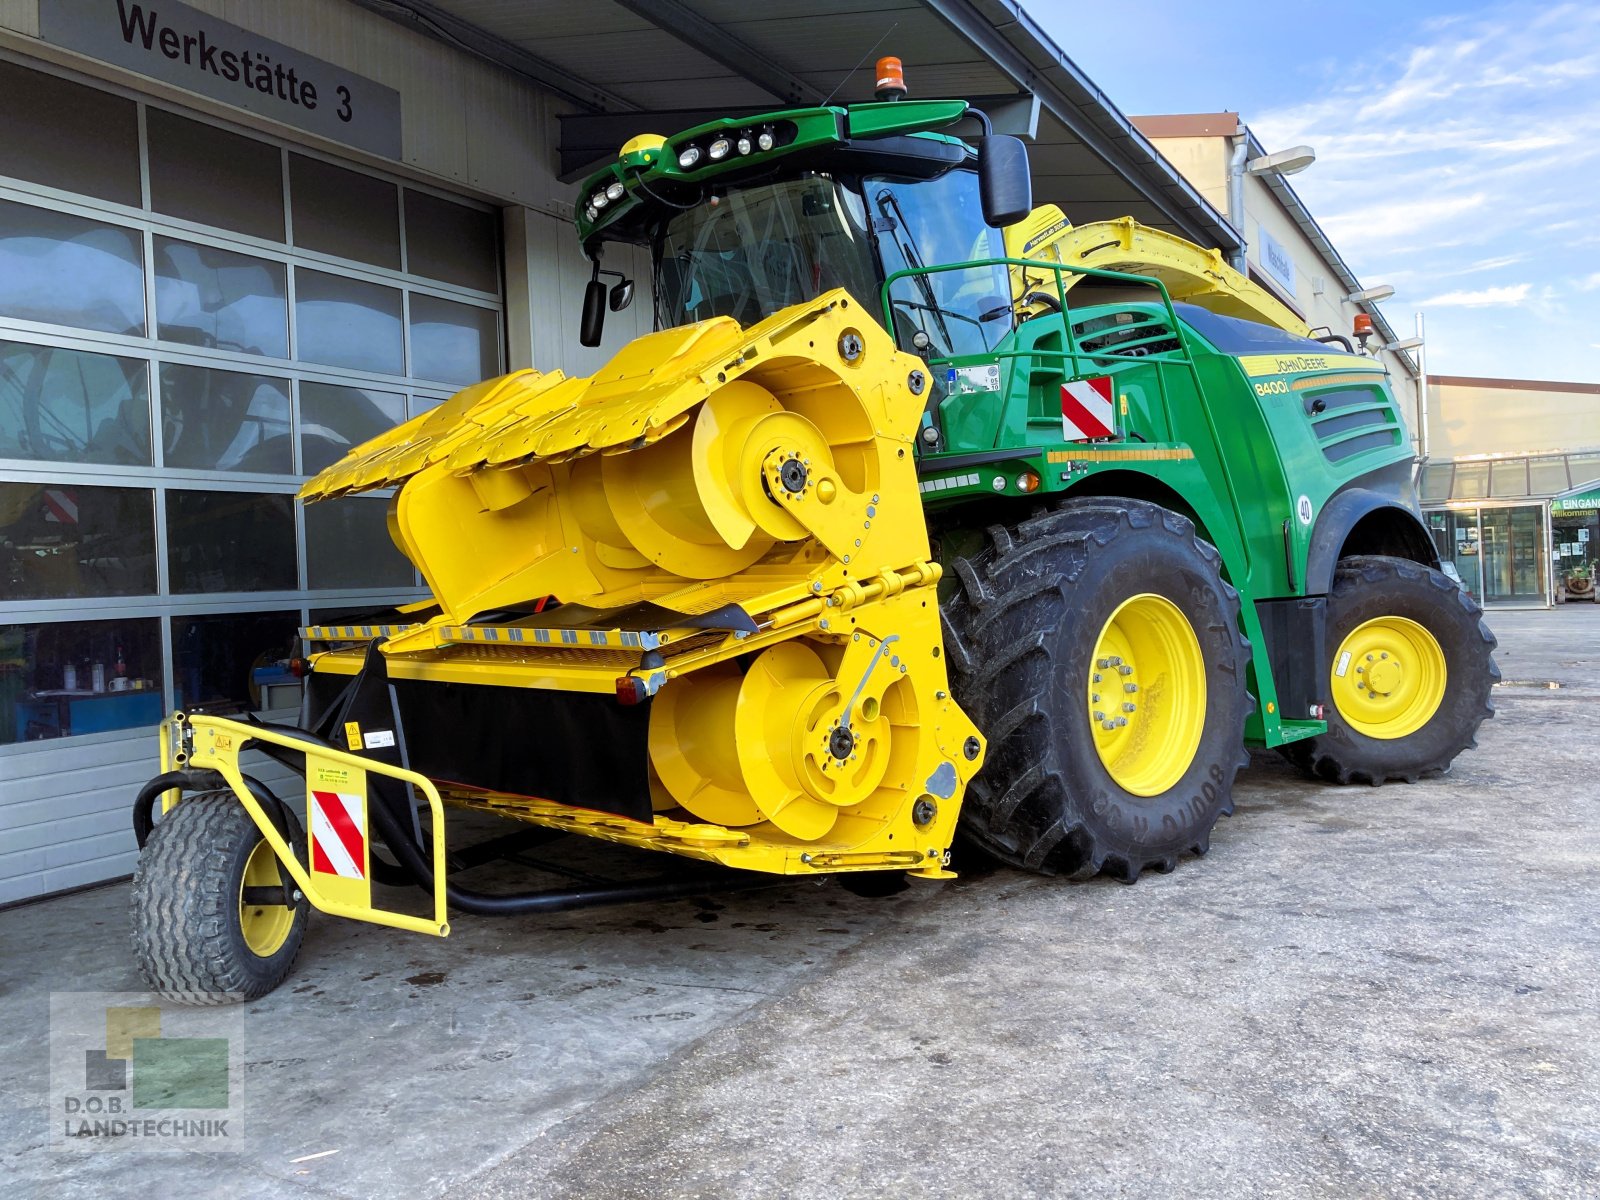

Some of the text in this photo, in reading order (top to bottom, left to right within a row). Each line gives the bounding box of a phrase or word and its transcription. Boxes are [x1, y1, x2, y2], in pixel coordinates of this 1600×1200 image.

[117, 0, 353, 123] Werkstätte 3
[1275, 357, 1329, 373] JOHN DEERE
[1254, 377, 1290, 397] 8400i
[1300, 500, 1310, 520] 40
